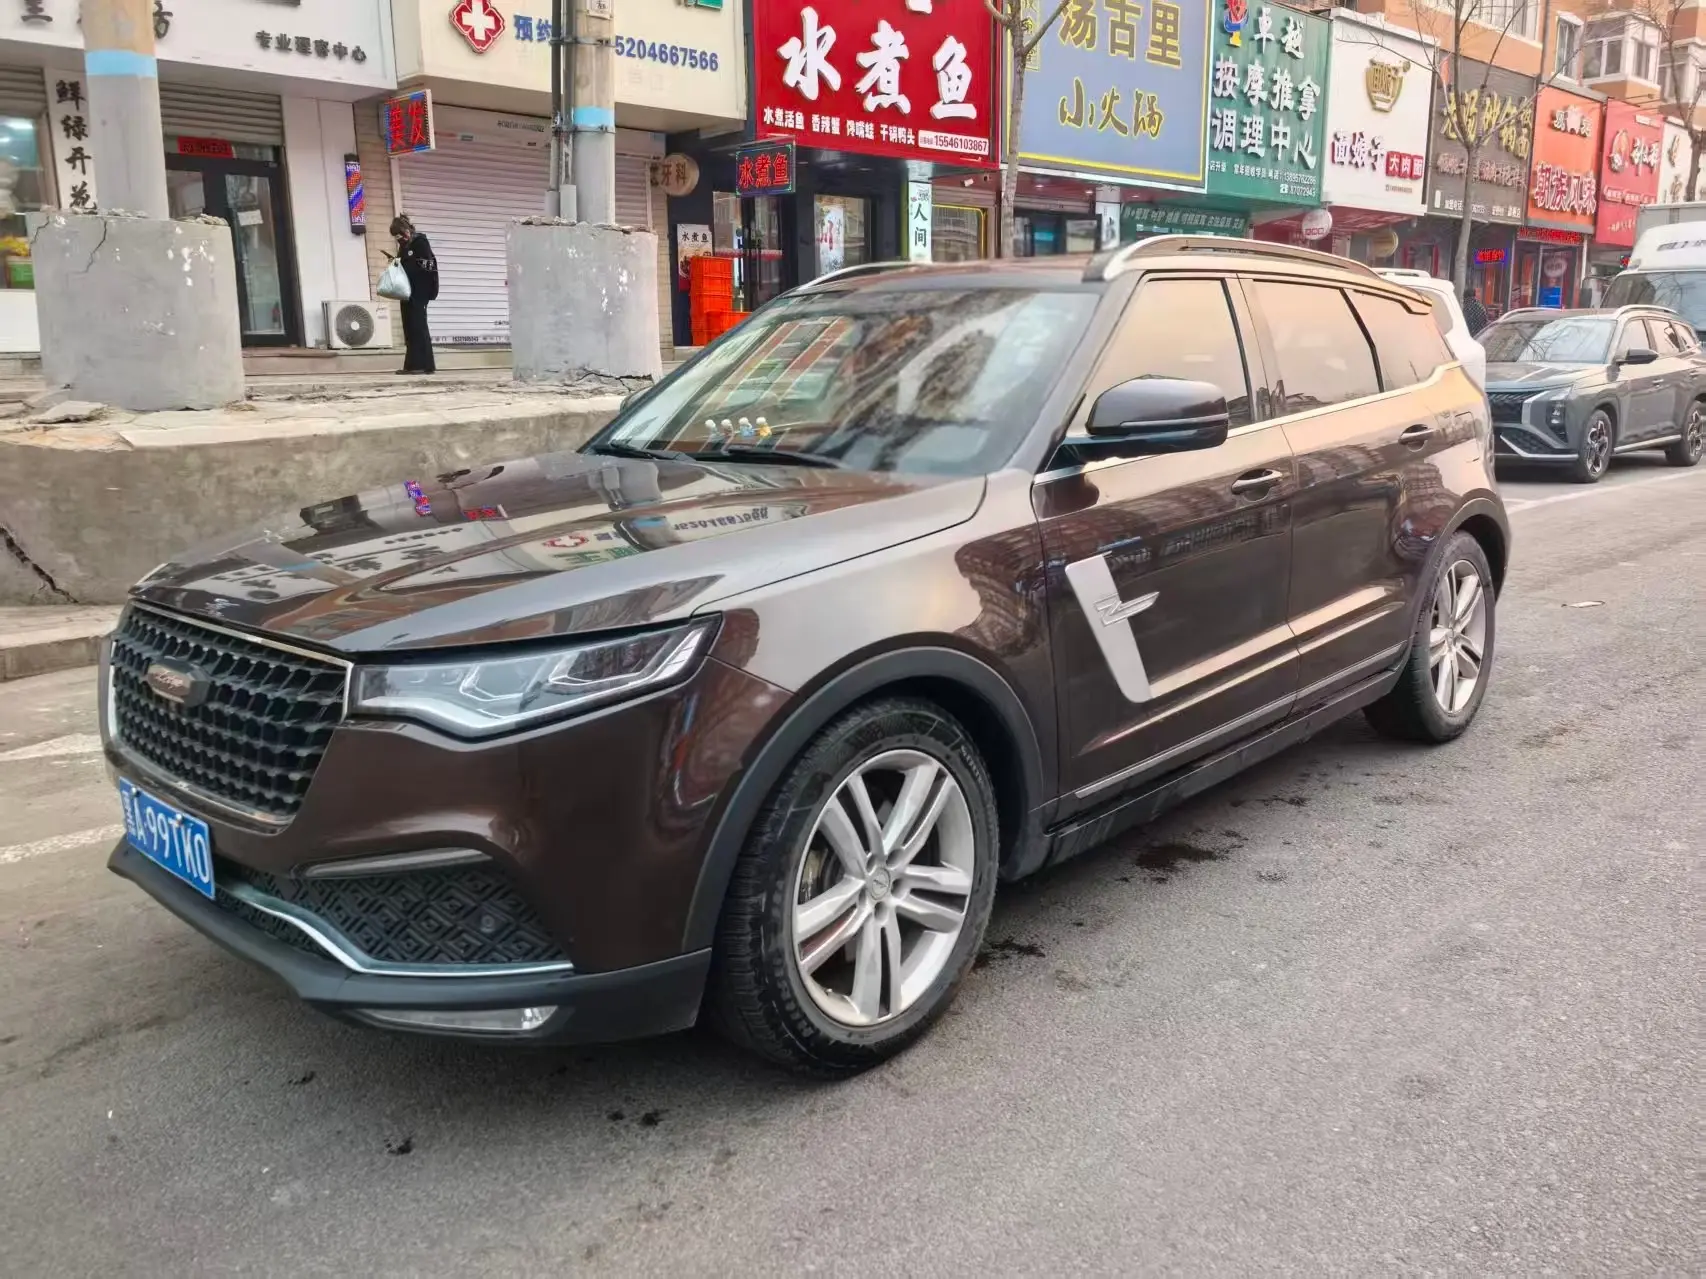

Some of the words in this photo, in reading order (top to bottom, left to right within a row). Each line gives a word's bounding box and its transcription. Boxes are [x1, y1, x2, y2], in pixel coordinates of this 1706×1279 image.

[1252, 8, 1305, 59] 卓越
[614, 35, 719, 71] 5204667566
[777, 5, 978, 120] 水煮鱼
[1214, 53, 1320, 120] 按摩推拿
[763, 106, 804, 130] 水煮活鱼
[811, 114, 841, 135] 香辣蟹
[1059, 76, 1164, 139] 小火锅
[934, 135, 987, 152] 15546103867
[1213, 109, 1317, 169] 调理中心
[660, 163, 687, 187] 牙科
[738, 152, 788, 188] 水煮鱼
[1389, 154, 1422, 177] 大肉面
[681, 232, 709, 243] 水煮鱼
[913, 203, 928, 250] 人间
